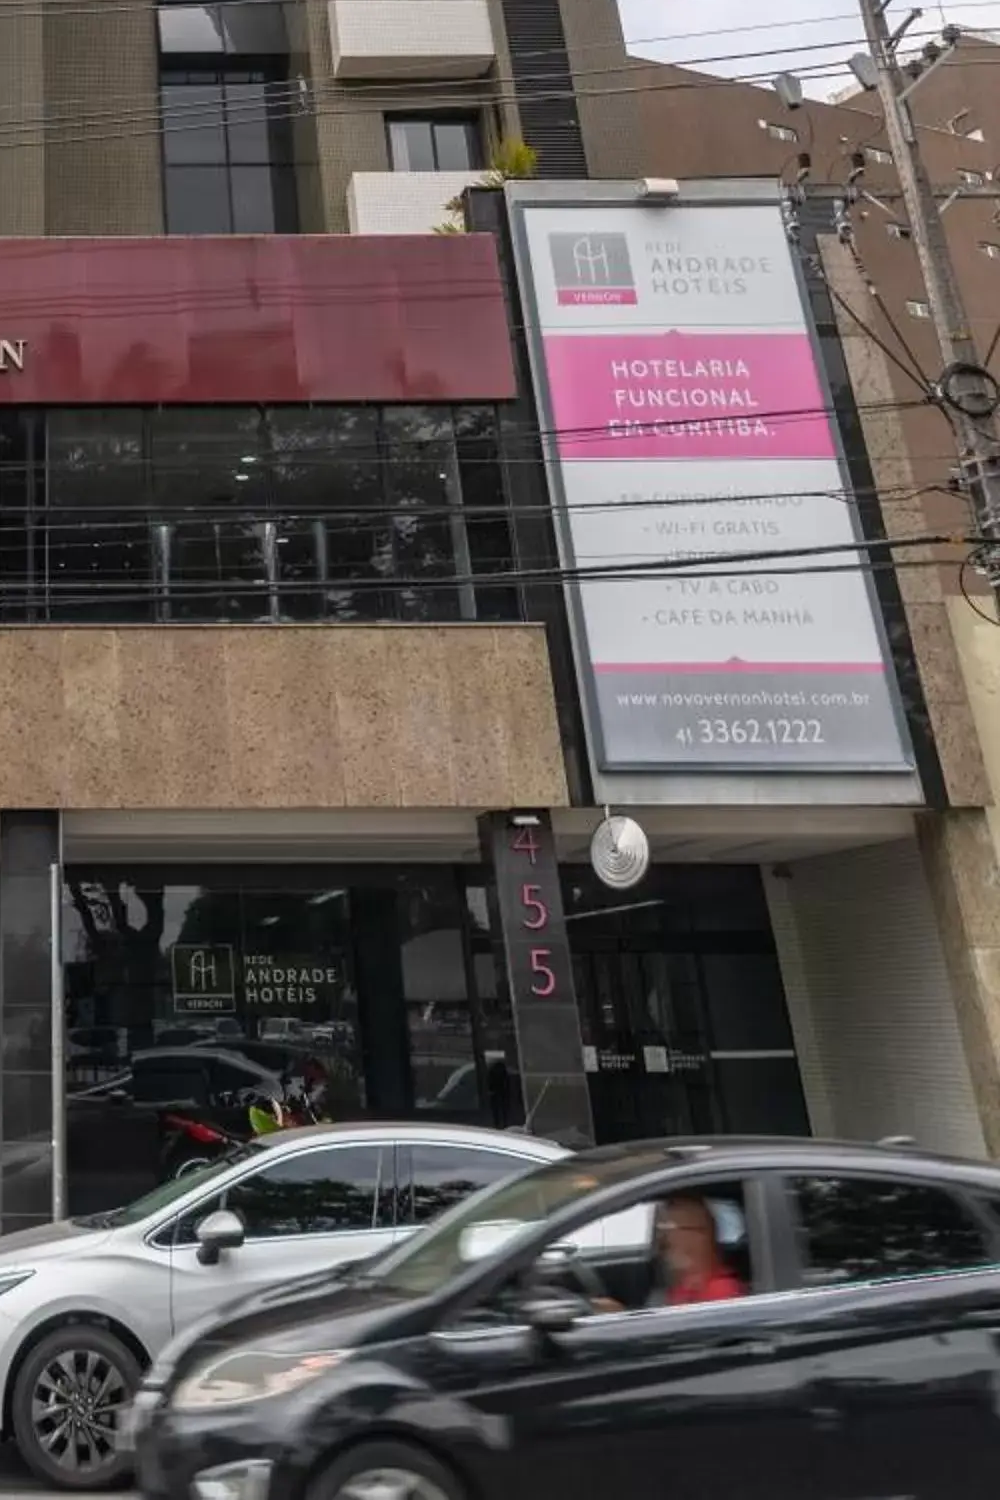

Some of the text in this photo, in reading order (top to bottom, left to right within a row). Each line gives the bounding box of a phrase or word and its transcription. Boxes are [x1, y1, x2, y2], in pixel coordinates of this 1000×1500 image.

[651, 256, 774, 274] ANDRADE
[611, 359, 750, 379] HOTELARIA
[614, 388, 760, 408] FUNCIONAL
[608, 419, 644, 438] EM
[678, 580, 701, 595] TV
[727, 580, 780, 595] CABO
[708, 609, 738, 625] DA
[699, 719, 826, 744] 3362.1222
[243, 955, 274, 966] REDE
[245, 968, 337, 984] ANDRADE
